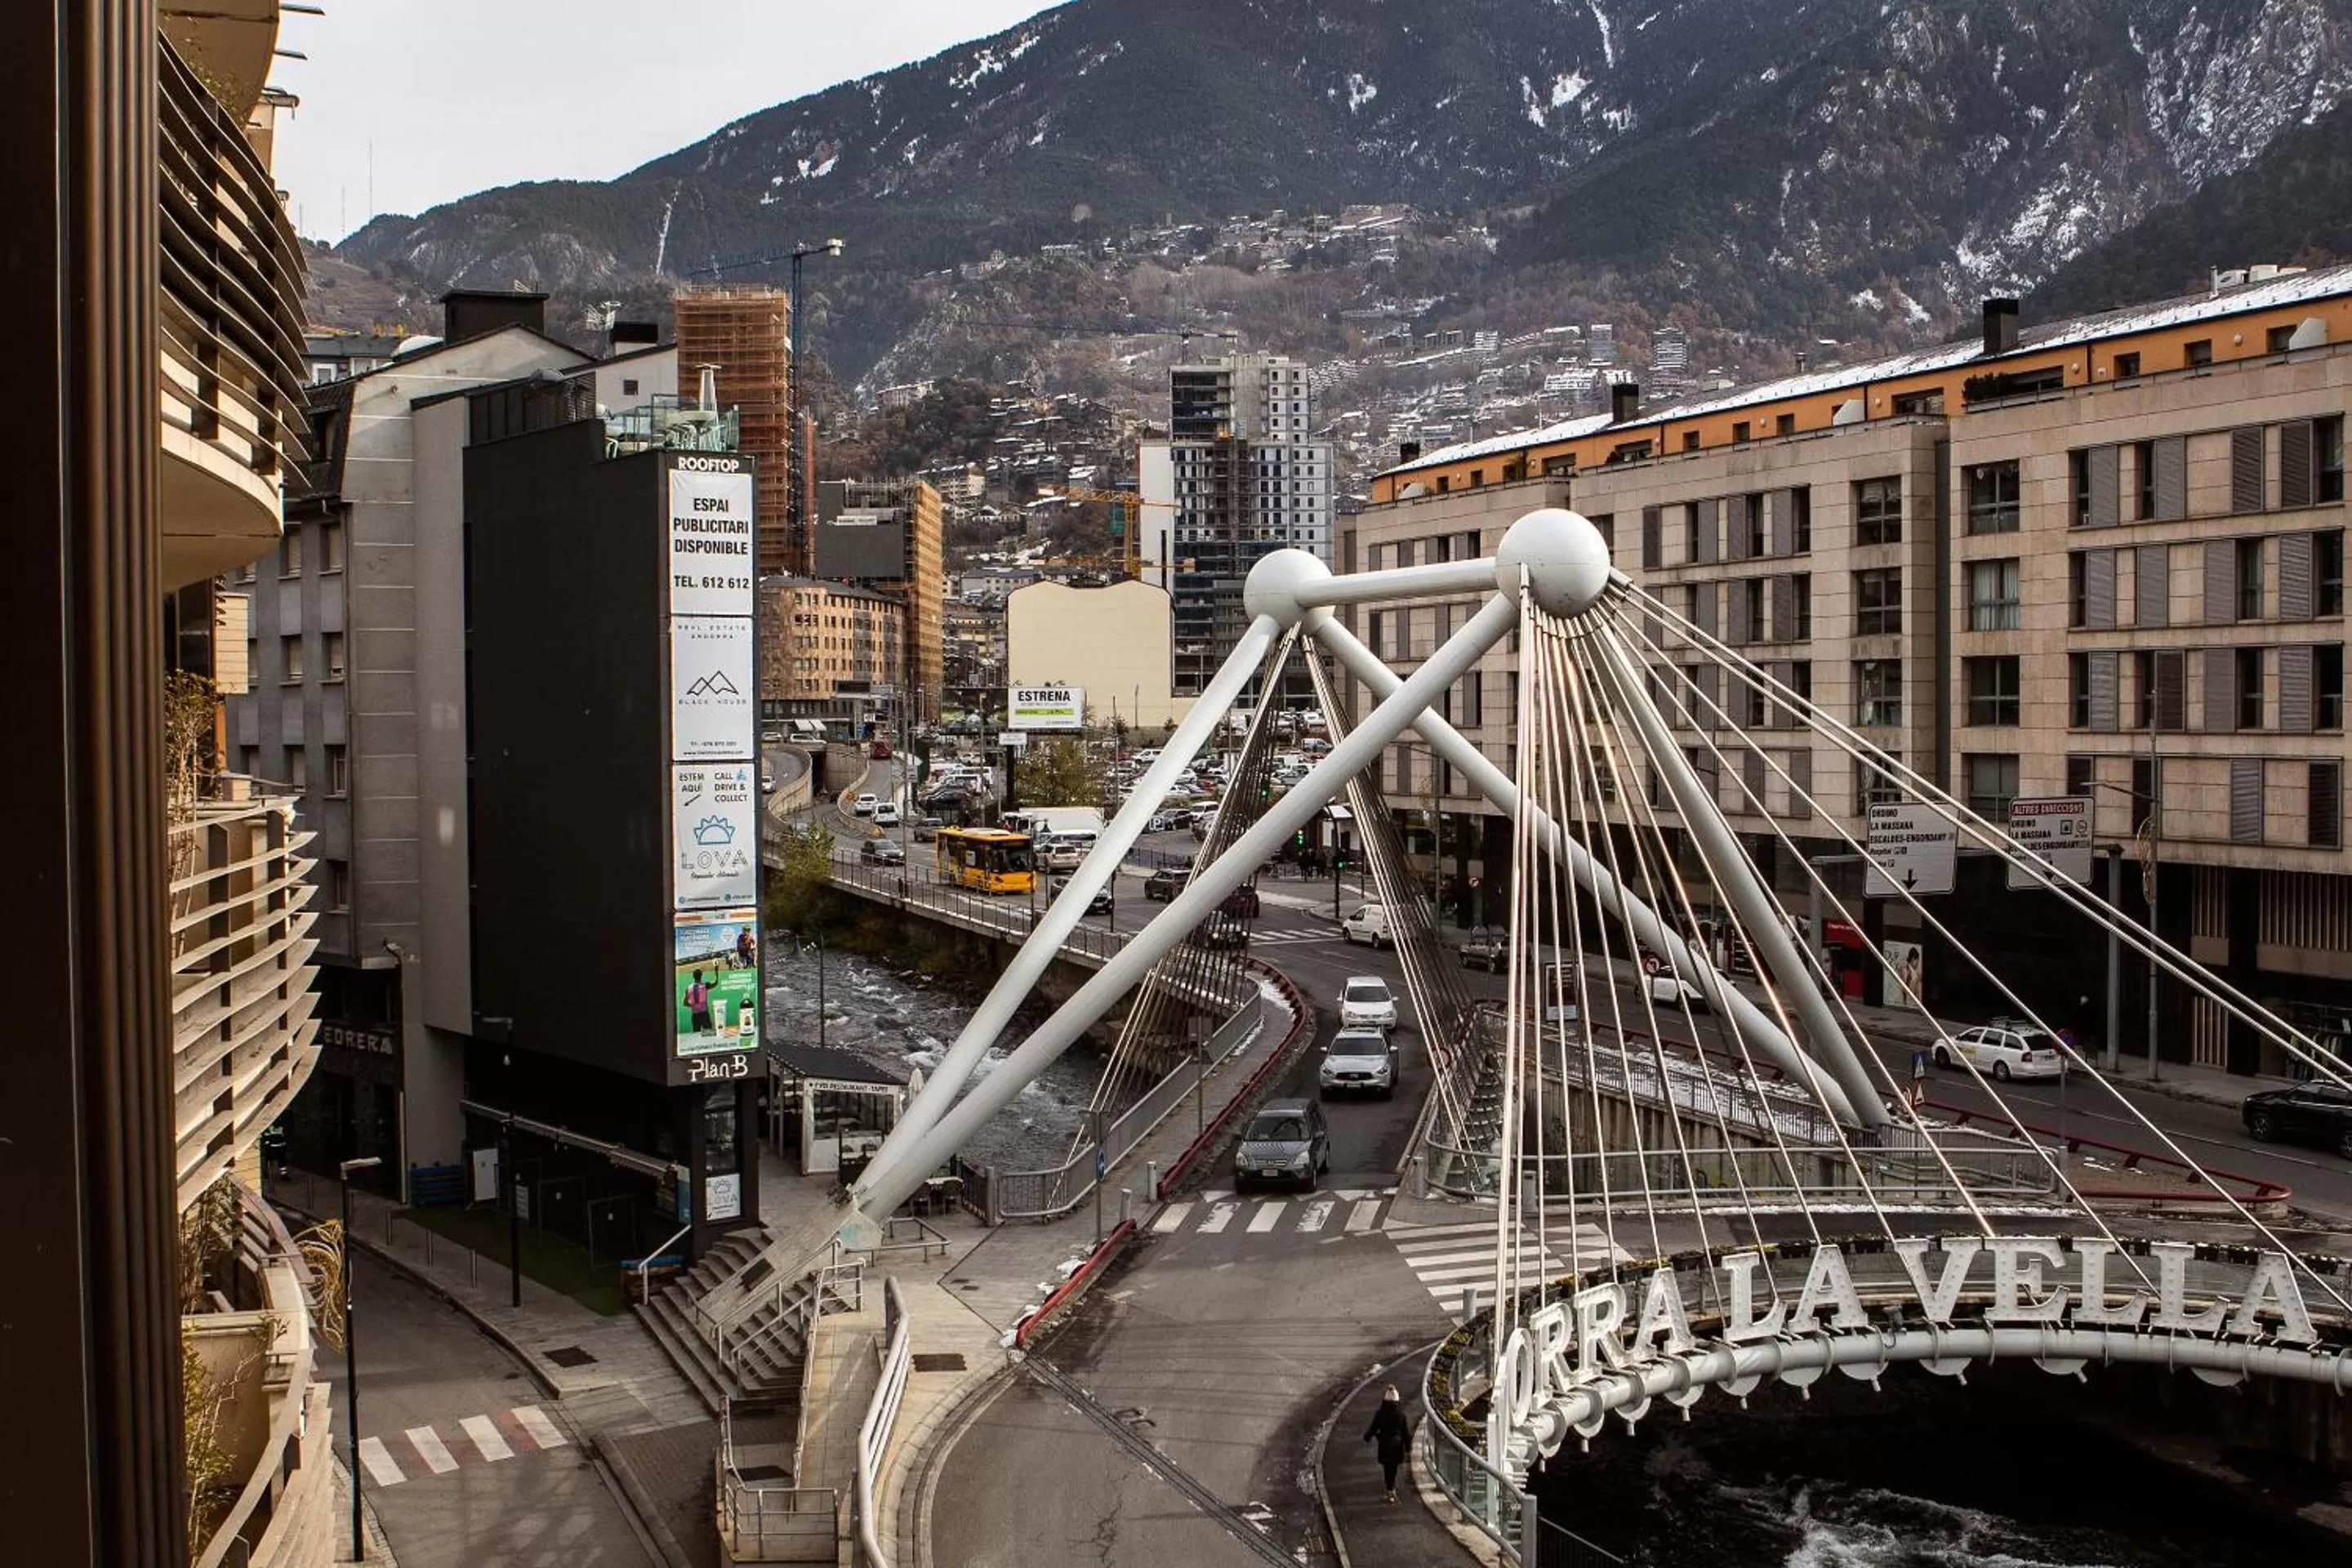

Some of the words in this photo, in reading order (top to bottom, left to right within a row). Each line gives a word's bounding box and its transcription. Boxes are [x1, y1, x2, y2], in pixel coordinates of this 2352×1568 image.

[679, 457, 739, 472] ROOFTOP
[694, 498, 728, 512] ESPAI
[674, 518, 749, 534] PUBLICITARI
[675, 539, 748, 555] DISPONIBLE
[674, 575, 698, 588] TEL.
[702, 577, 724, 589] 612
[728, 577, 750, 589] 612
[1018, 691, 1071, 702] ESTRENA
[679, 773, 705, 782] ESTEM
[715, 783, 737, 791] DRIVE
[1881, 822, 1913, 830] MASSANA
[2020, 831, 2051, 839] MASSANA
[682, 850, 748, 869] LOVA
[324, 1027, 393, 1054] EDRERA
[688, 1058, 730, 1082] Plan
[731, 1055, 748, 1077] B
[1722, 1245, 1869, 1343] LA
[1894, 1236, 2318, 1343] VELLA
